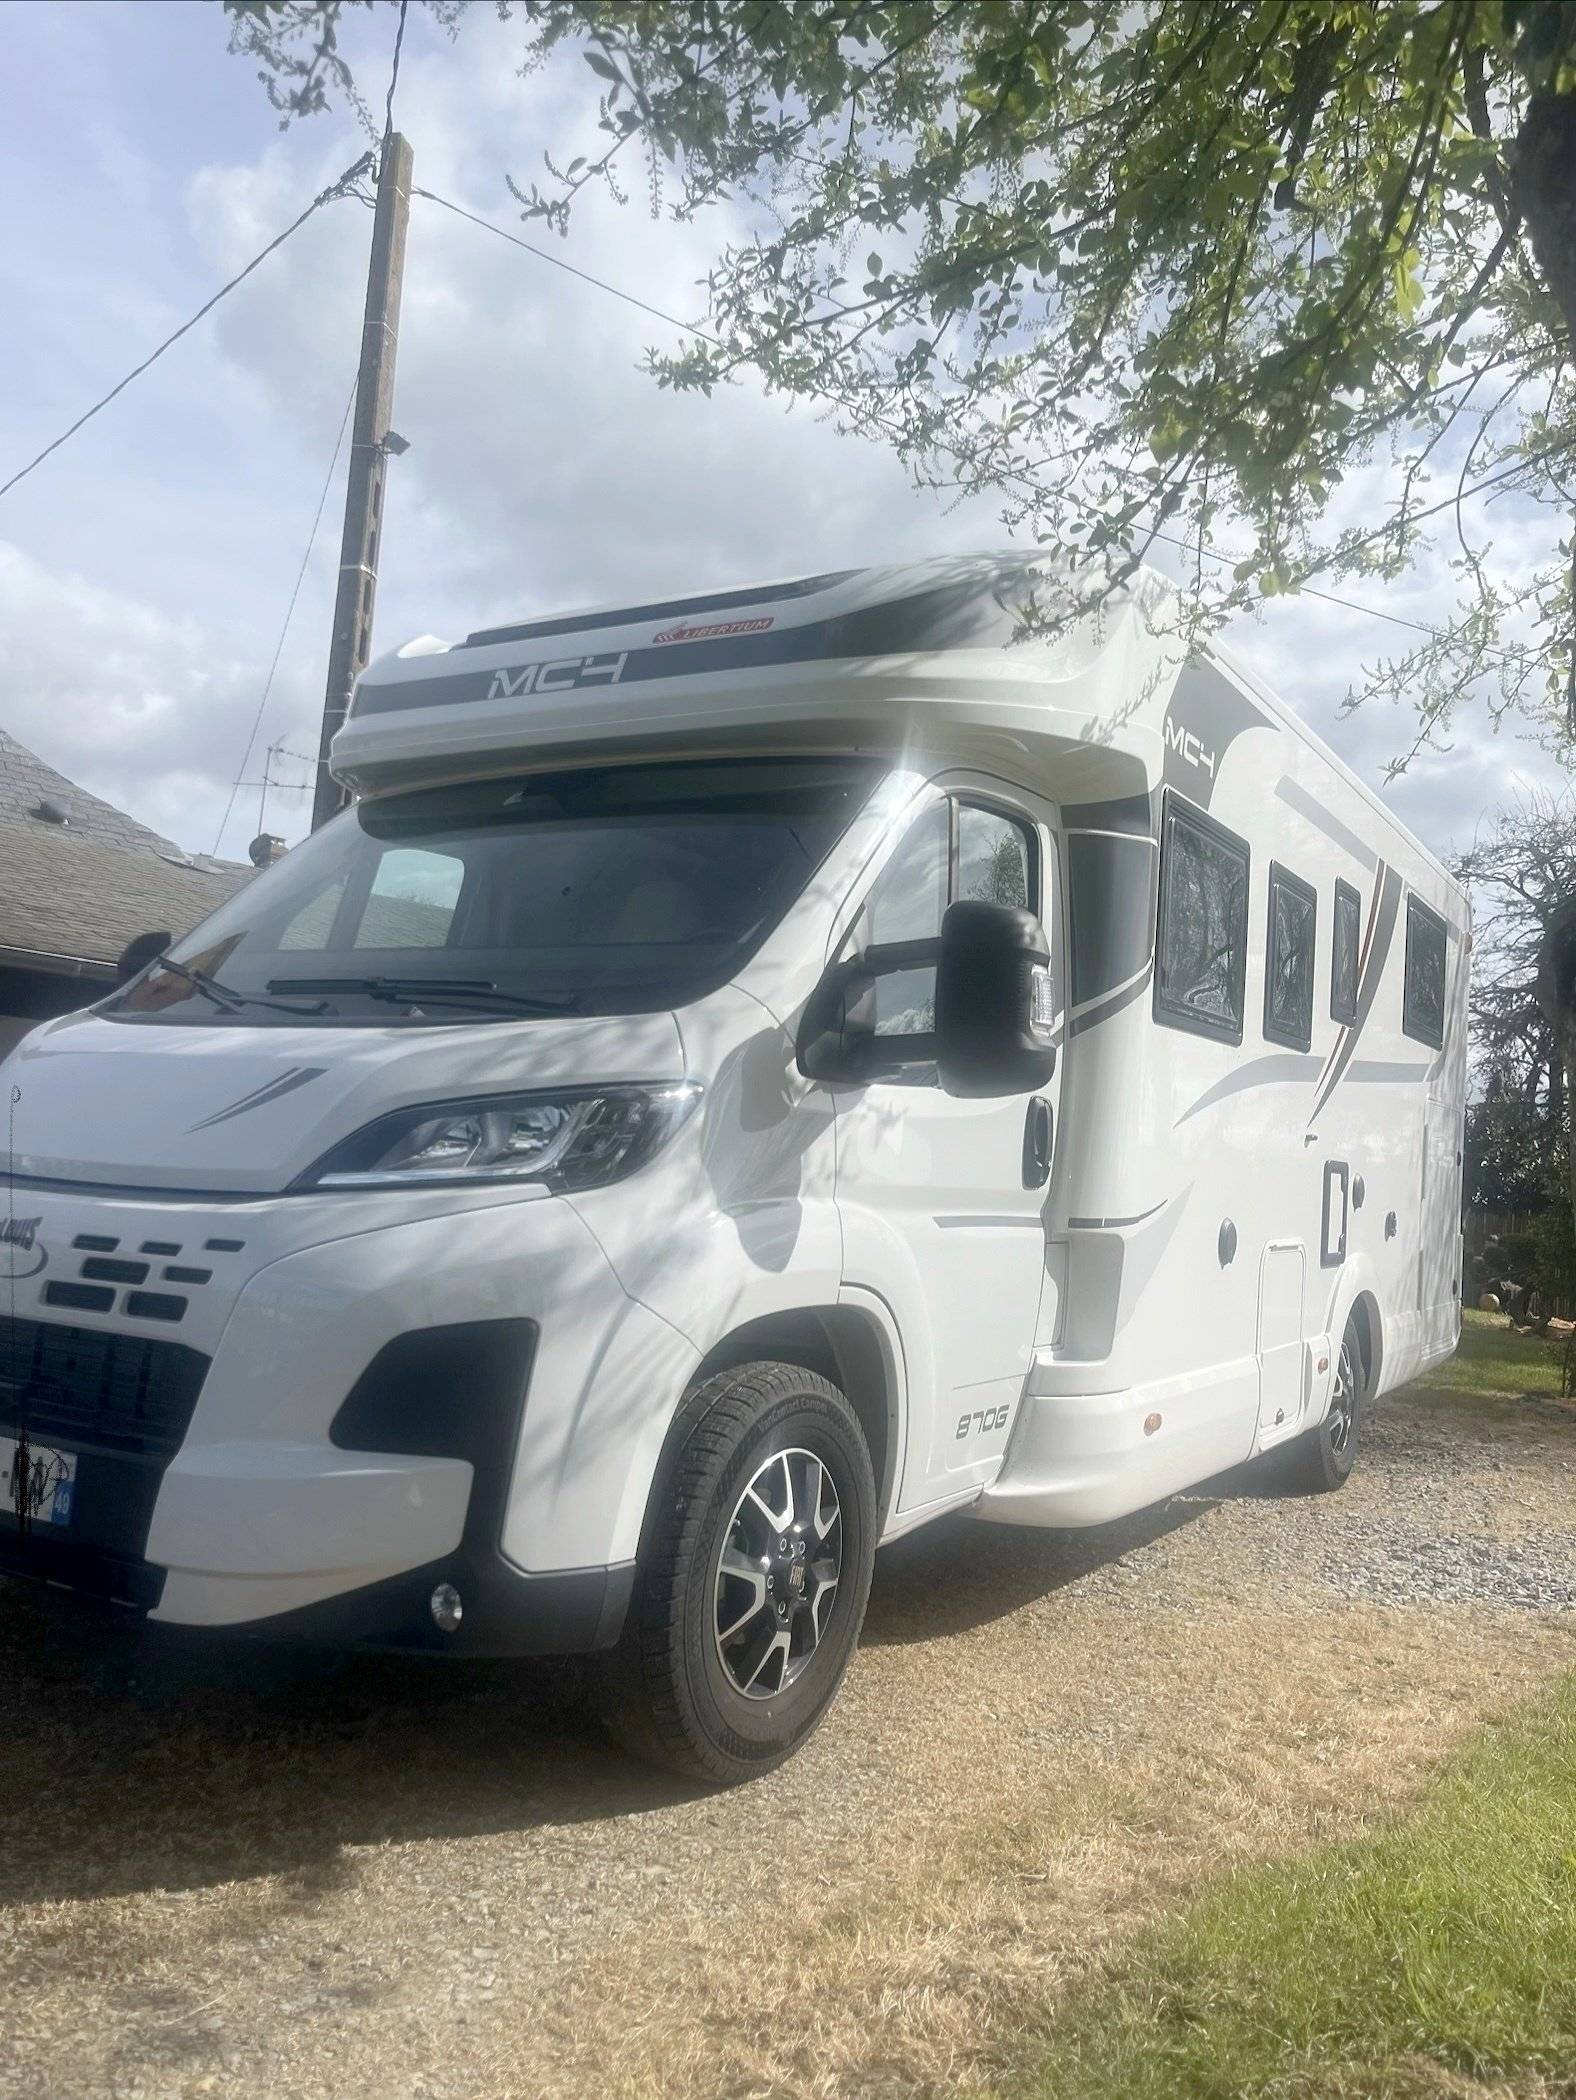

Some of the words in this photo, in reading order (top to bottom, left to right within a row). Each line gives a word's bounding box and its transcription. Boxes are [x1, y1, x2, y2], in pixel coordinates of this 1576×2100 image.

[683, 619, 771, 640] LIBERTIUM
[488, 652, 629, 700] MC4
[1165, 715, 1215, 779] MC4
